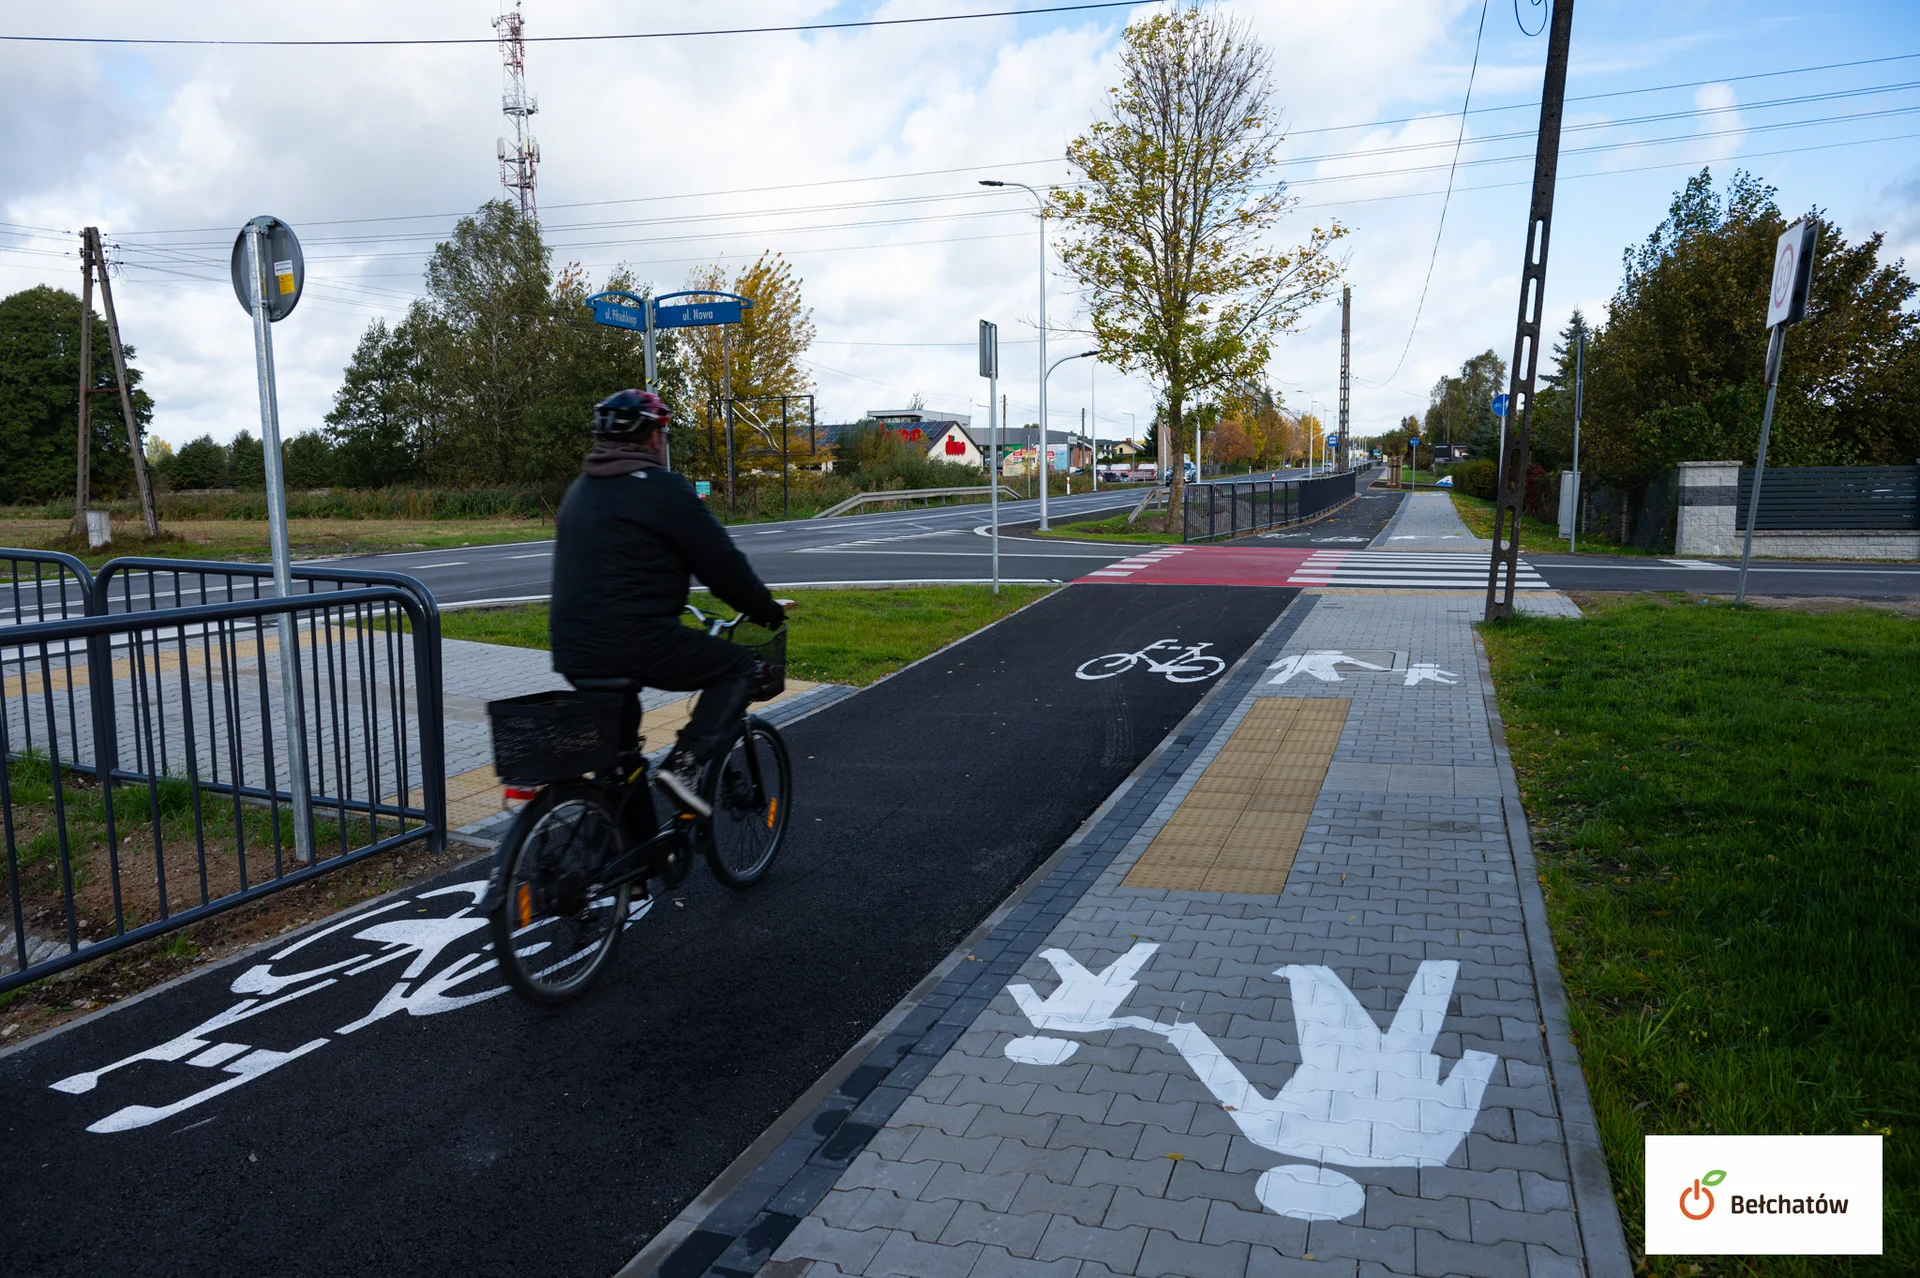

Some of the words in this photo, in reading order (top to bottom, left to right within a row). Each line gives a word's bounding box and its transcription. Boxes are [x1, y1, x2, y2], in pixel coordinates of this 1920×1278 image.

[1776, 259, 1791, 294] 30
[682, 308, 692, 321] ul.
[693, 308, 714, 320] Nowa
